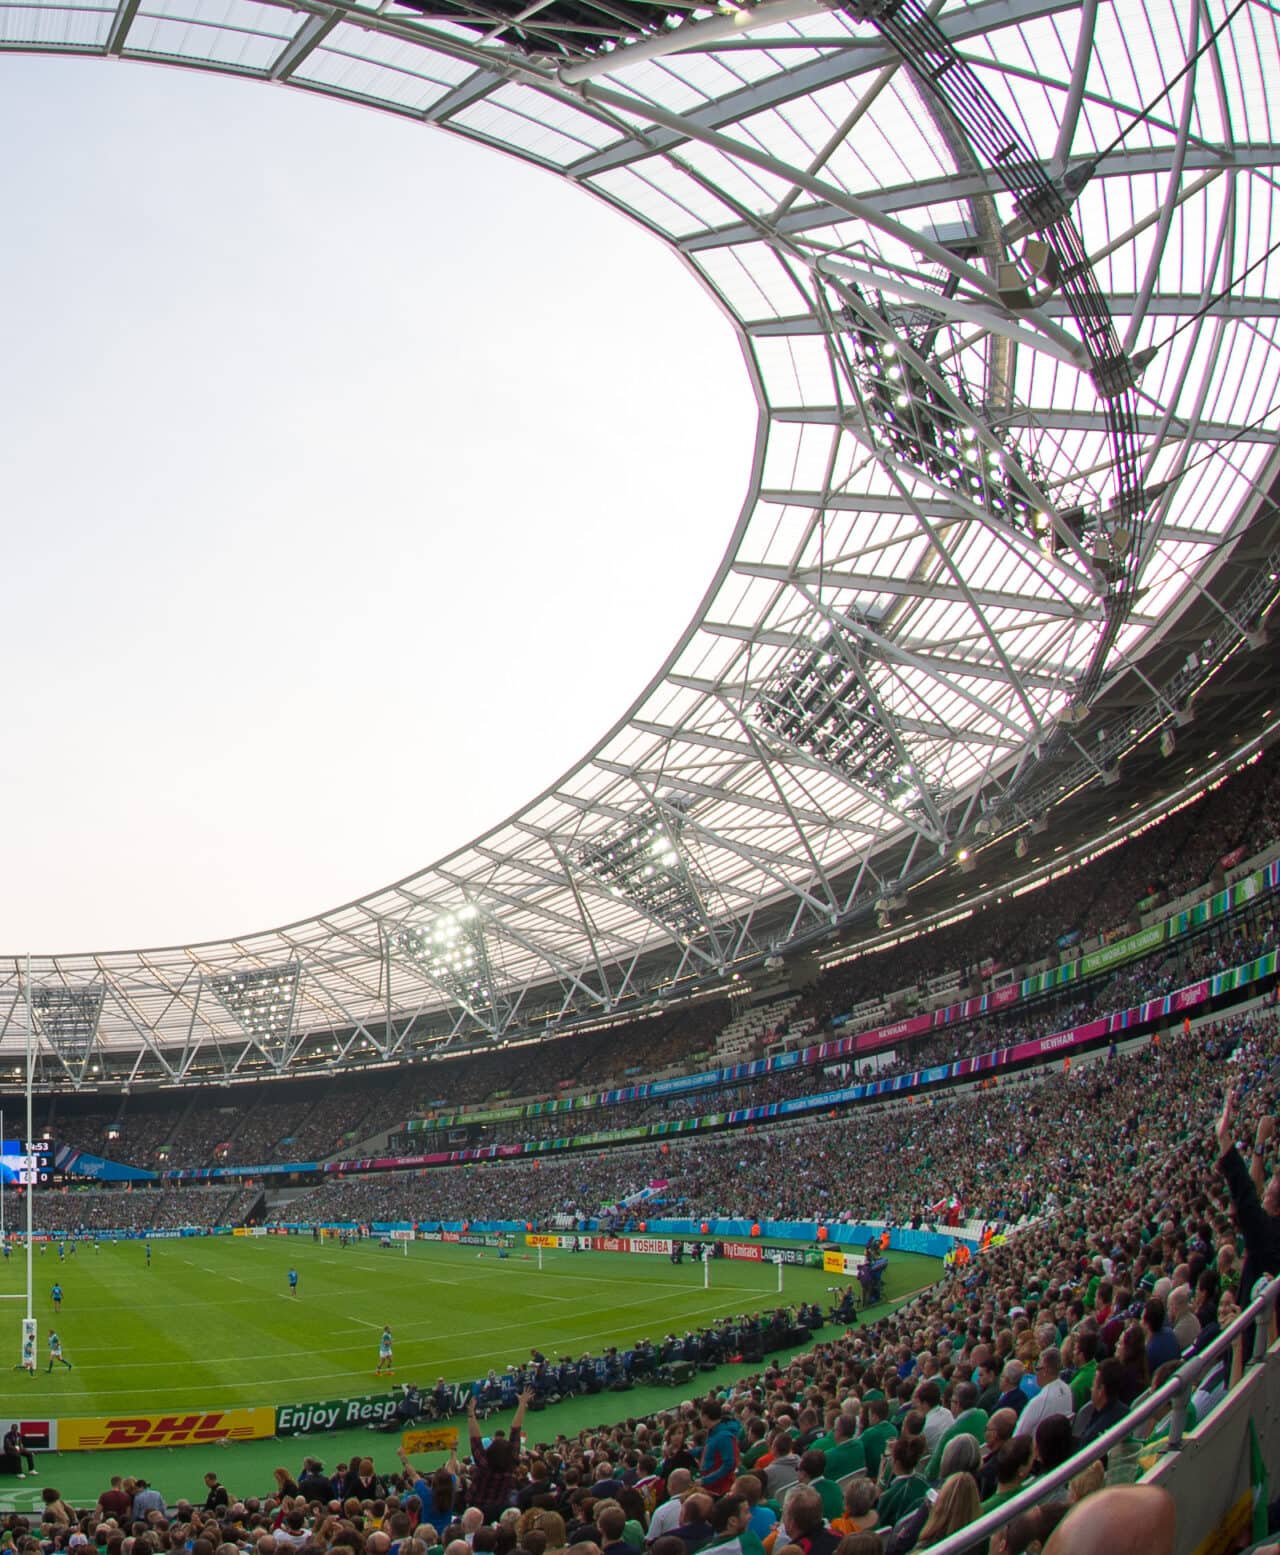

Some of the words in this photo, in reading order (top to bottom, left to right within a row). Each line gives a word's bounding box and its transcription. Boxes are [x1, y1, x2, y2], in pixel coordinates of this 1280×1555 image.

[878, 1024, 907, 1038] NEWHAM
[1040, 1032, 1074, 1049] NEWHAM
[41, 1158, 48, 1166] 3
[632, 1240, 669, 1252] TOSHIBA
[723, 1242, 734, 1256] Fly
[734, 1244, 759, 1258] Emirates
[279, 1406, 340, 1431] Enjoy
[103, 1414, 230, 1444] DHL
